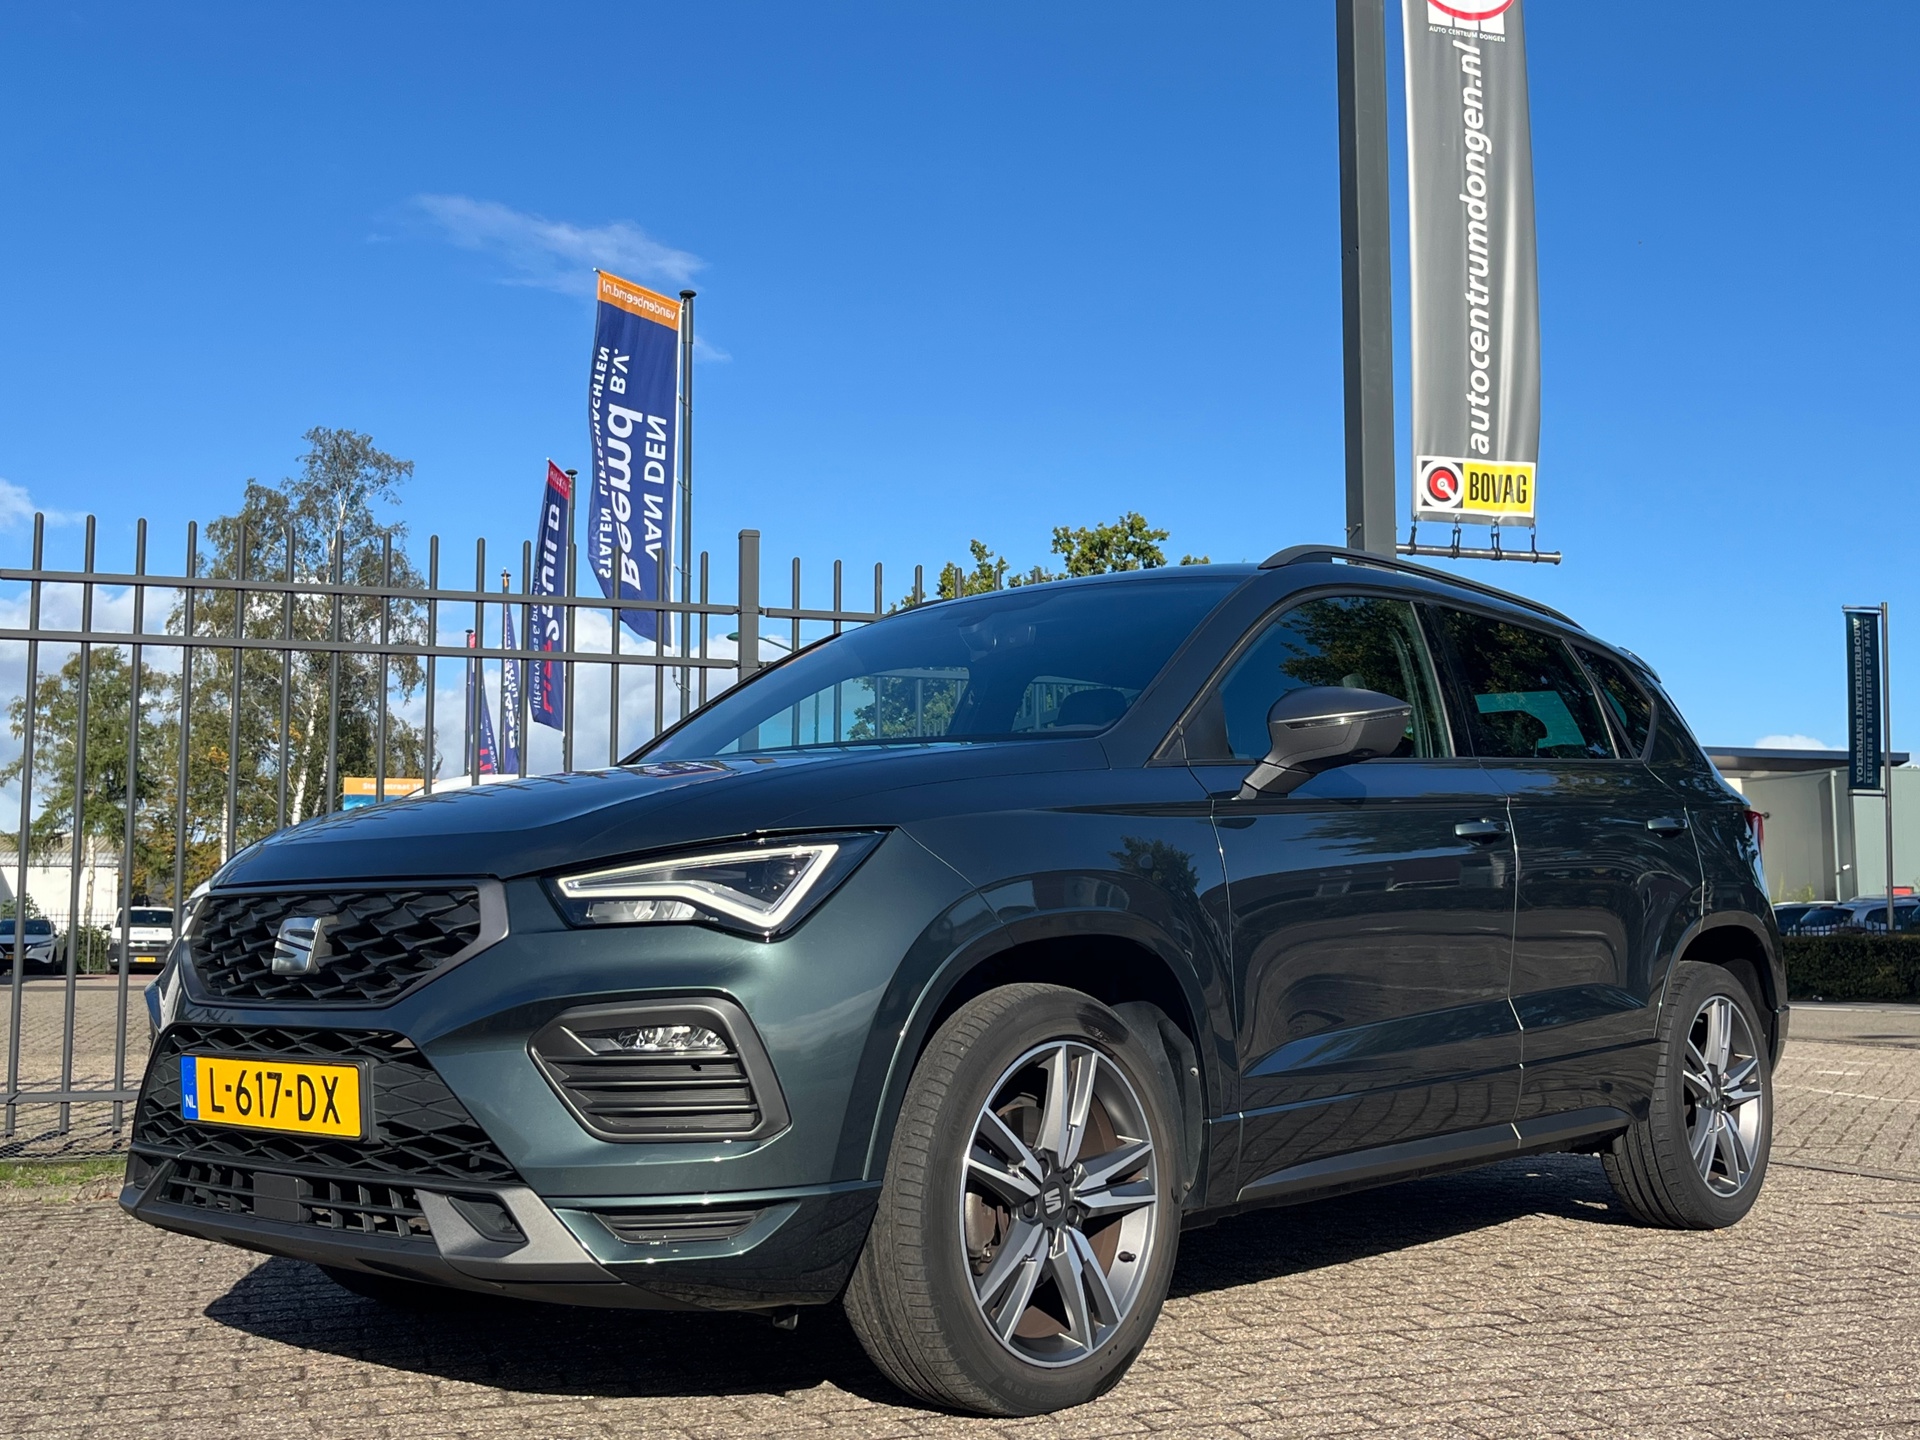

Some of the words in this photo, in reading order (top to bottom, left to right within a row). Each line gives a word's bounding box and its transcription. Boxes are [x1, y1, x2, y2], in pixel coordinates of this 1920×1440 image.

[1428, 25, 1446, 34] AUTO
[1448, 28, 1478, 39] CENTRUM
[1479, 33, 1506, 43] DONGEN
[1453, 39, 1492, 455] autocentrumdongen.nl
[1469, 471, 1527, 504] BOVAG
[1852, 618, 1864, 716] INTERIEURBOUW
[1865, 651, 1872, 665] OP
[1856, 718, 1864, 783] VOERMANS
[185, 1095, 197, 1109] NL
[209, 1067, 341, 1124] L-617-DX
